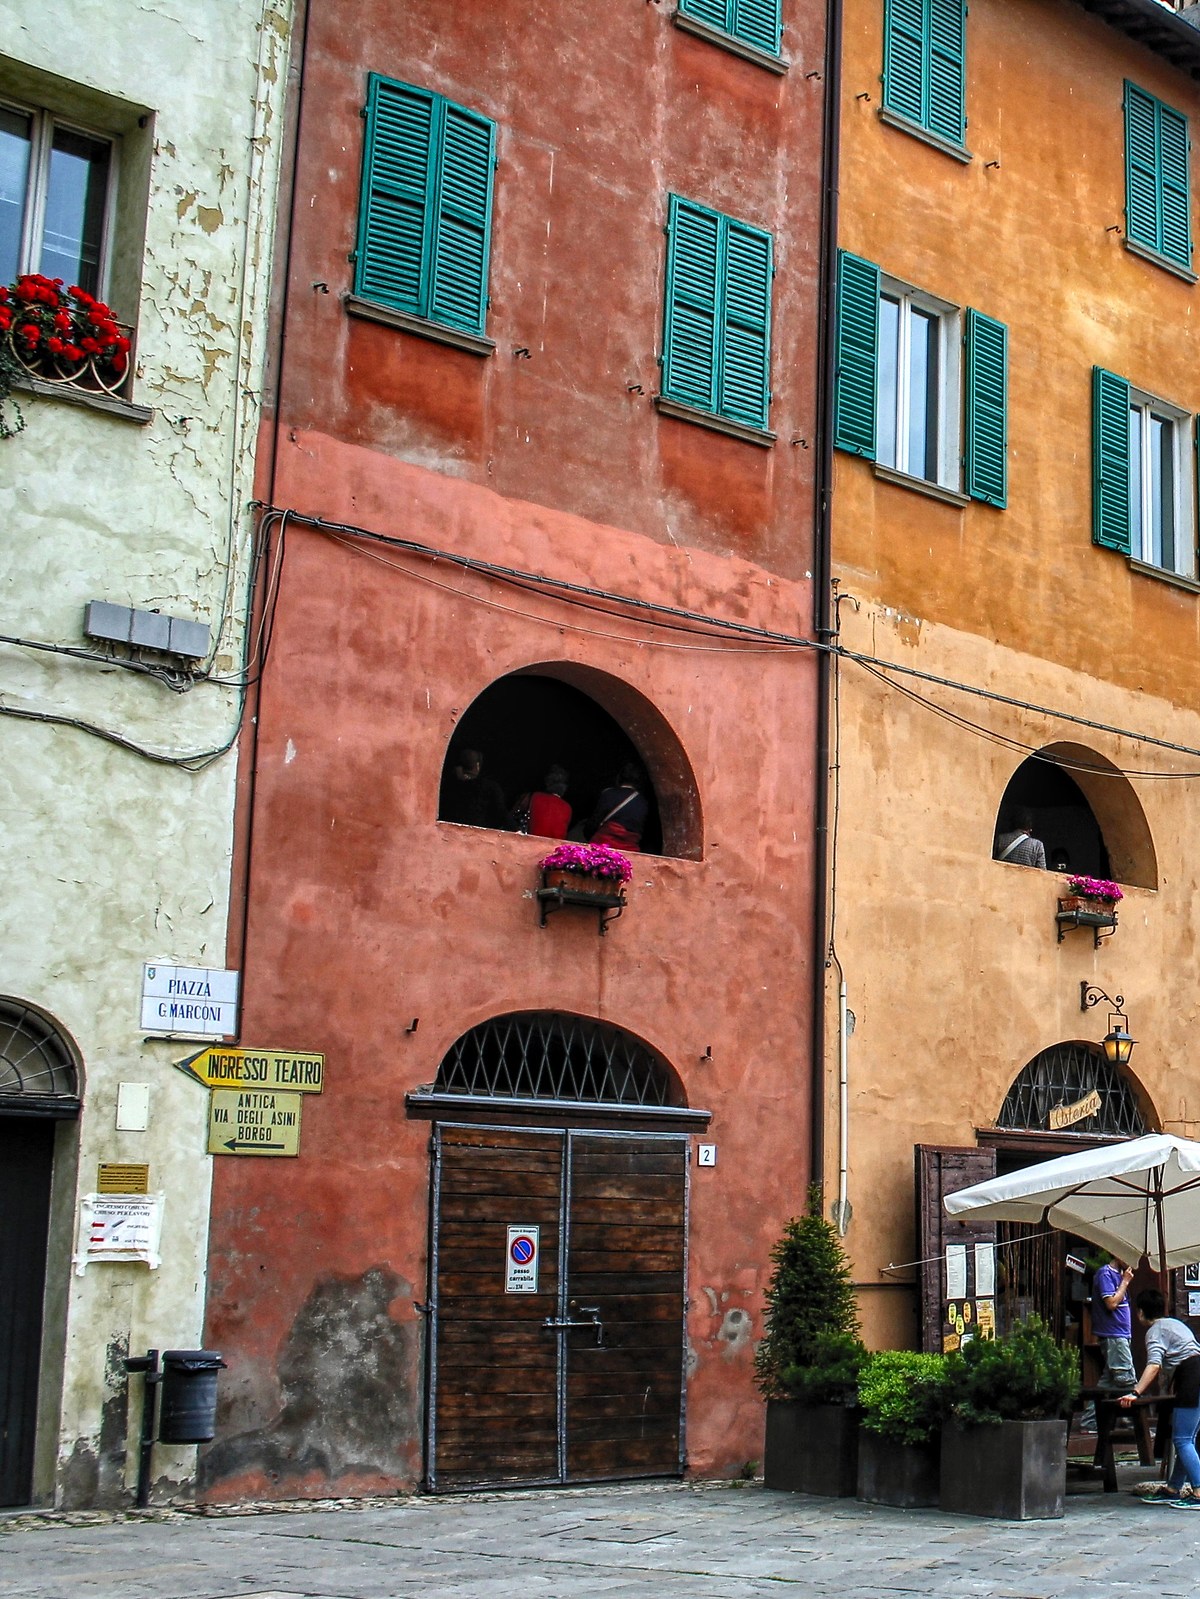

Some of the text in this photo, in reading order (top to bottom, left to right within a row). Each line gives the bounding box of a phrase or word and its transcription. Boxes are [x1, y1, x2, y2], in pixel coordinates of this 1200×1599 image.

[168, 979, 211, 997] PIAZZA
[169, 1003, 221, 1021] MARCONI
[207, 1054, 321, 1084] INGRESSO TEATRO
[238, 1093, 275, 1109] ANTICA
[214, 1108, 296, 1126] VIA DEGLI ASINI
[1055, 1096, 1098, 1128] Osteria
[238, 1127, 272, 1141] BORGO
[704, 1149, 710, 1162] 2
